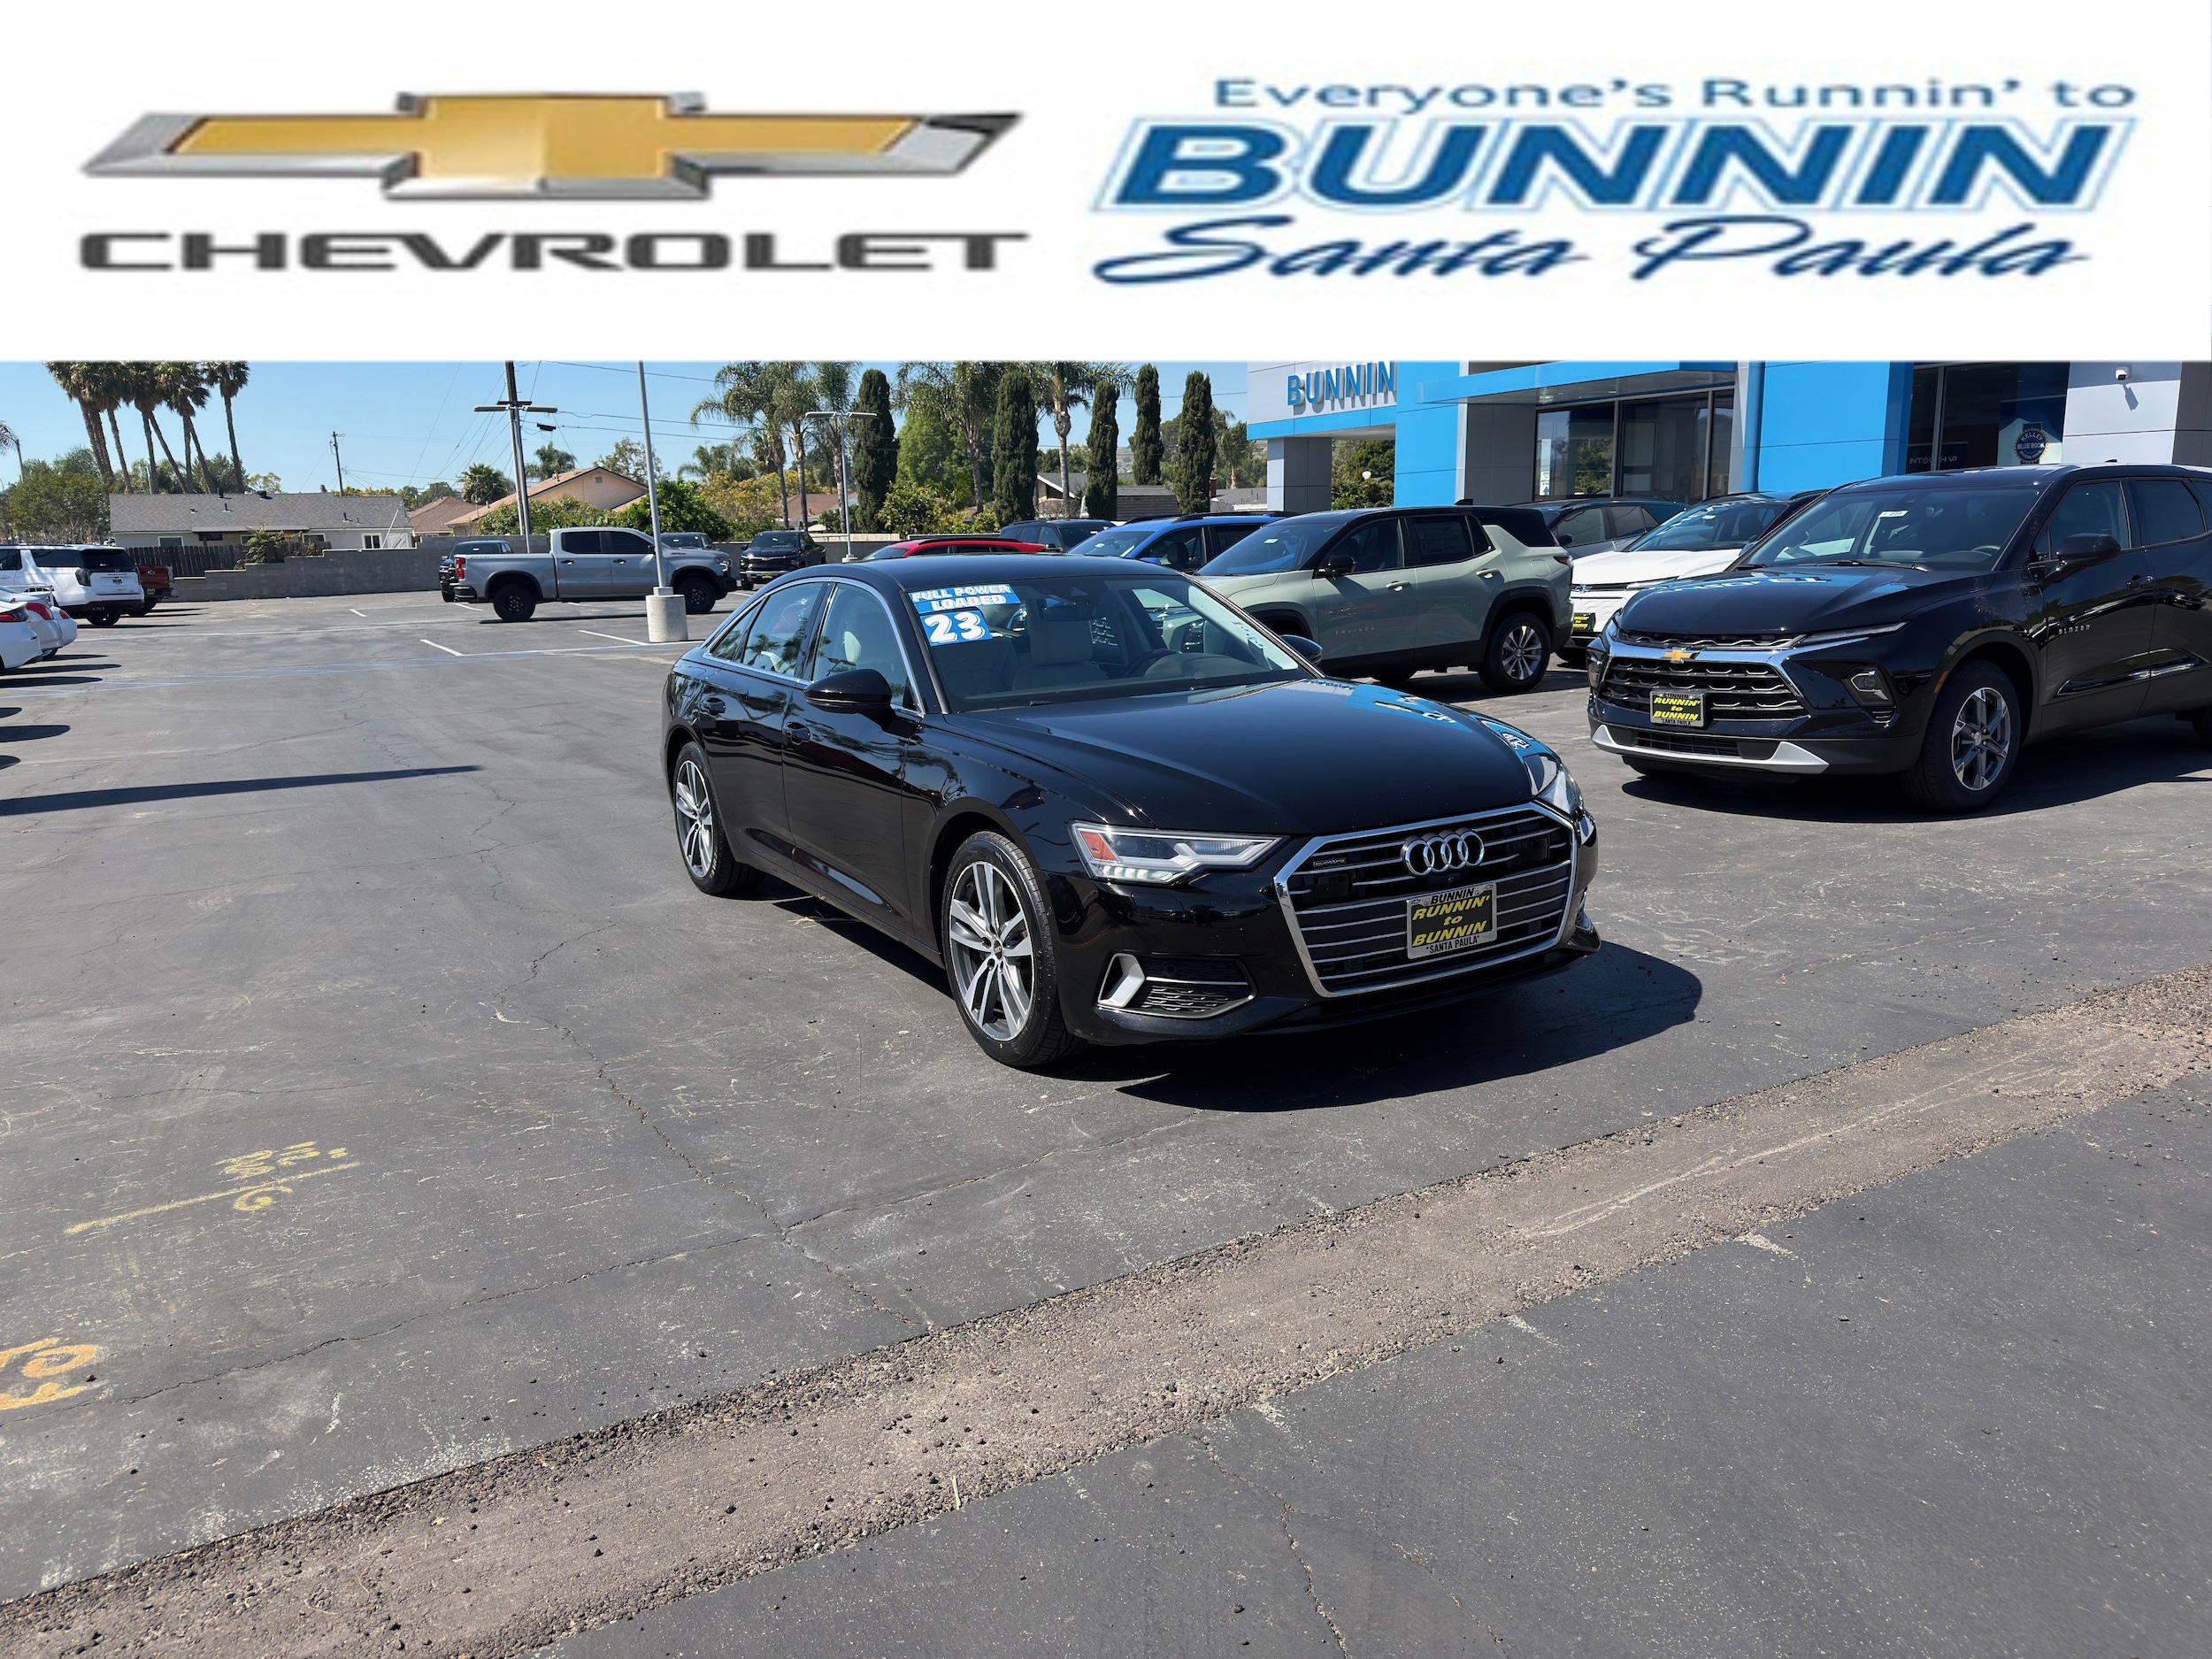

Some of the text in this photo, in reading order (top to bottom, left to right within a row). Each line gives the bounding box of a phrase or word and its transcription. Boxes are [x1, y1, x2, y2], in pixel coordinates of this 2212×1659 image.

[1287, 361, 1396, 406] BUNNIN
[2020, 432, 2044, 442] KELLEY
[1909, 456, 1947, 465] INTOH
[912, 584, 1012, 603] FULL POWER
[931, 594, 1007, 611] LOADED
[924, 611, 986, 642] 23
[2058, 624, 2091, 635] BLAZER
[1654, 697, 1701, 706] RUNNIN'
[1653, 710, 1699, 720] BUNNIN
[1431, 887, 1475, 904] BUNNIN
[1412, 895, 1490, 920] RUNNIN'
[1443, 915, 1463, 926] to
[1412, 920, 1487, 947] BUNNIN
